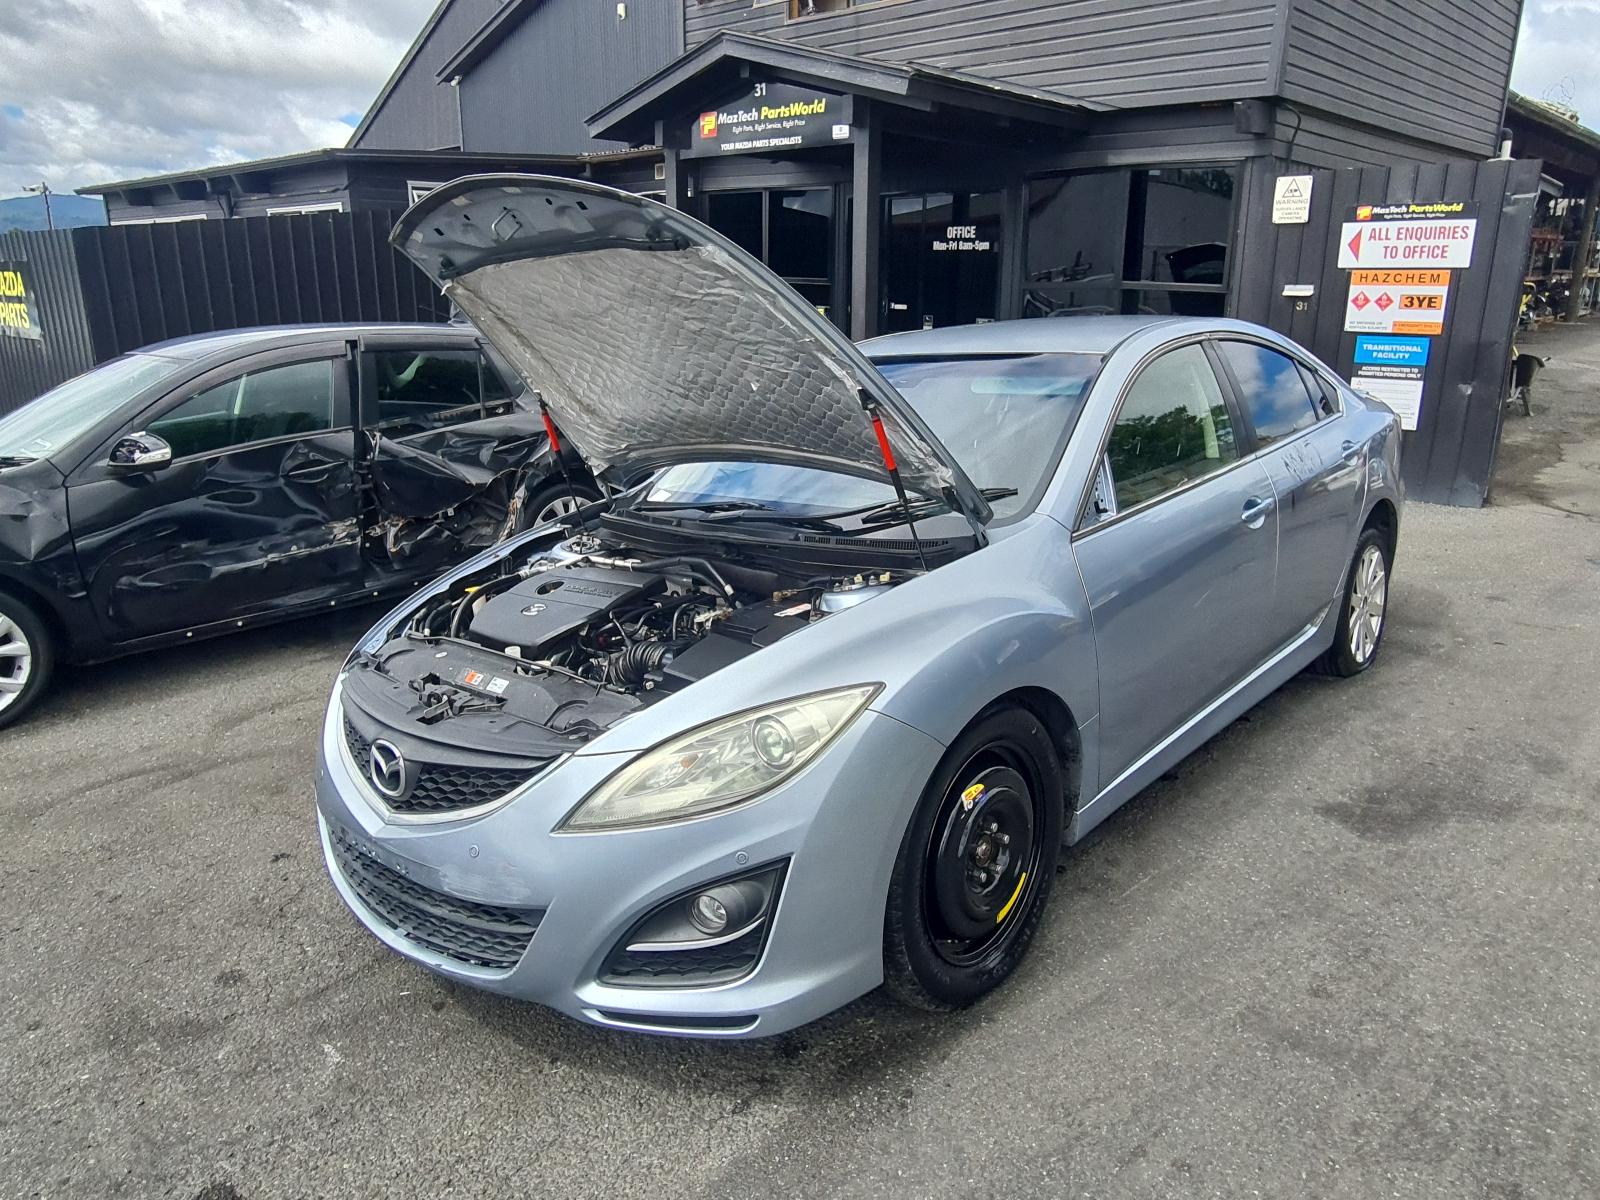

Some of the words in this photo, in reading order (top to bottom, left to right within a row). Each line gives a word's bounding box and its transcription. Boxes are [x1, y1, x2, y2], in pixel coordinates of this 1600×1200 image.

[754, 82, 766, 97] 31
[718, 108, 758, 124] MazTech
[760, 98, 826, 120] PartsWorld
[720, 142, 734, 151] YOUR
[735, 140, 752, 150] MAZDA
[753, 139, 769, 148] PARTS
[770, 136, 802, 146] SPECIALISTS
[1372, 205, 1407, 214] MazTech
[1409, 203, 1464, 213] PartsWorld
[946, 226, 976, 239] OFFICE
[1368, 228, 1391, 241] ALL
[1396, 226, 1470, 242] ENQUIRIES
[933, 240, 957, 251] Mon-Fri
[958, 240, 990, 252] 8am-5pm
[1383, 245, 1398, 259] TO
[1402, 244, 1449, 259] OFFICE
[1360, 273, 1441, 283] HAZCHEM
[1296, 302, 1308, 311] 31
[1404, 296, 1438, 309] 3YE
[0, 302, 30, 329] PARTS
[1363, 344, 1422, 352] TRANSITIONAL
